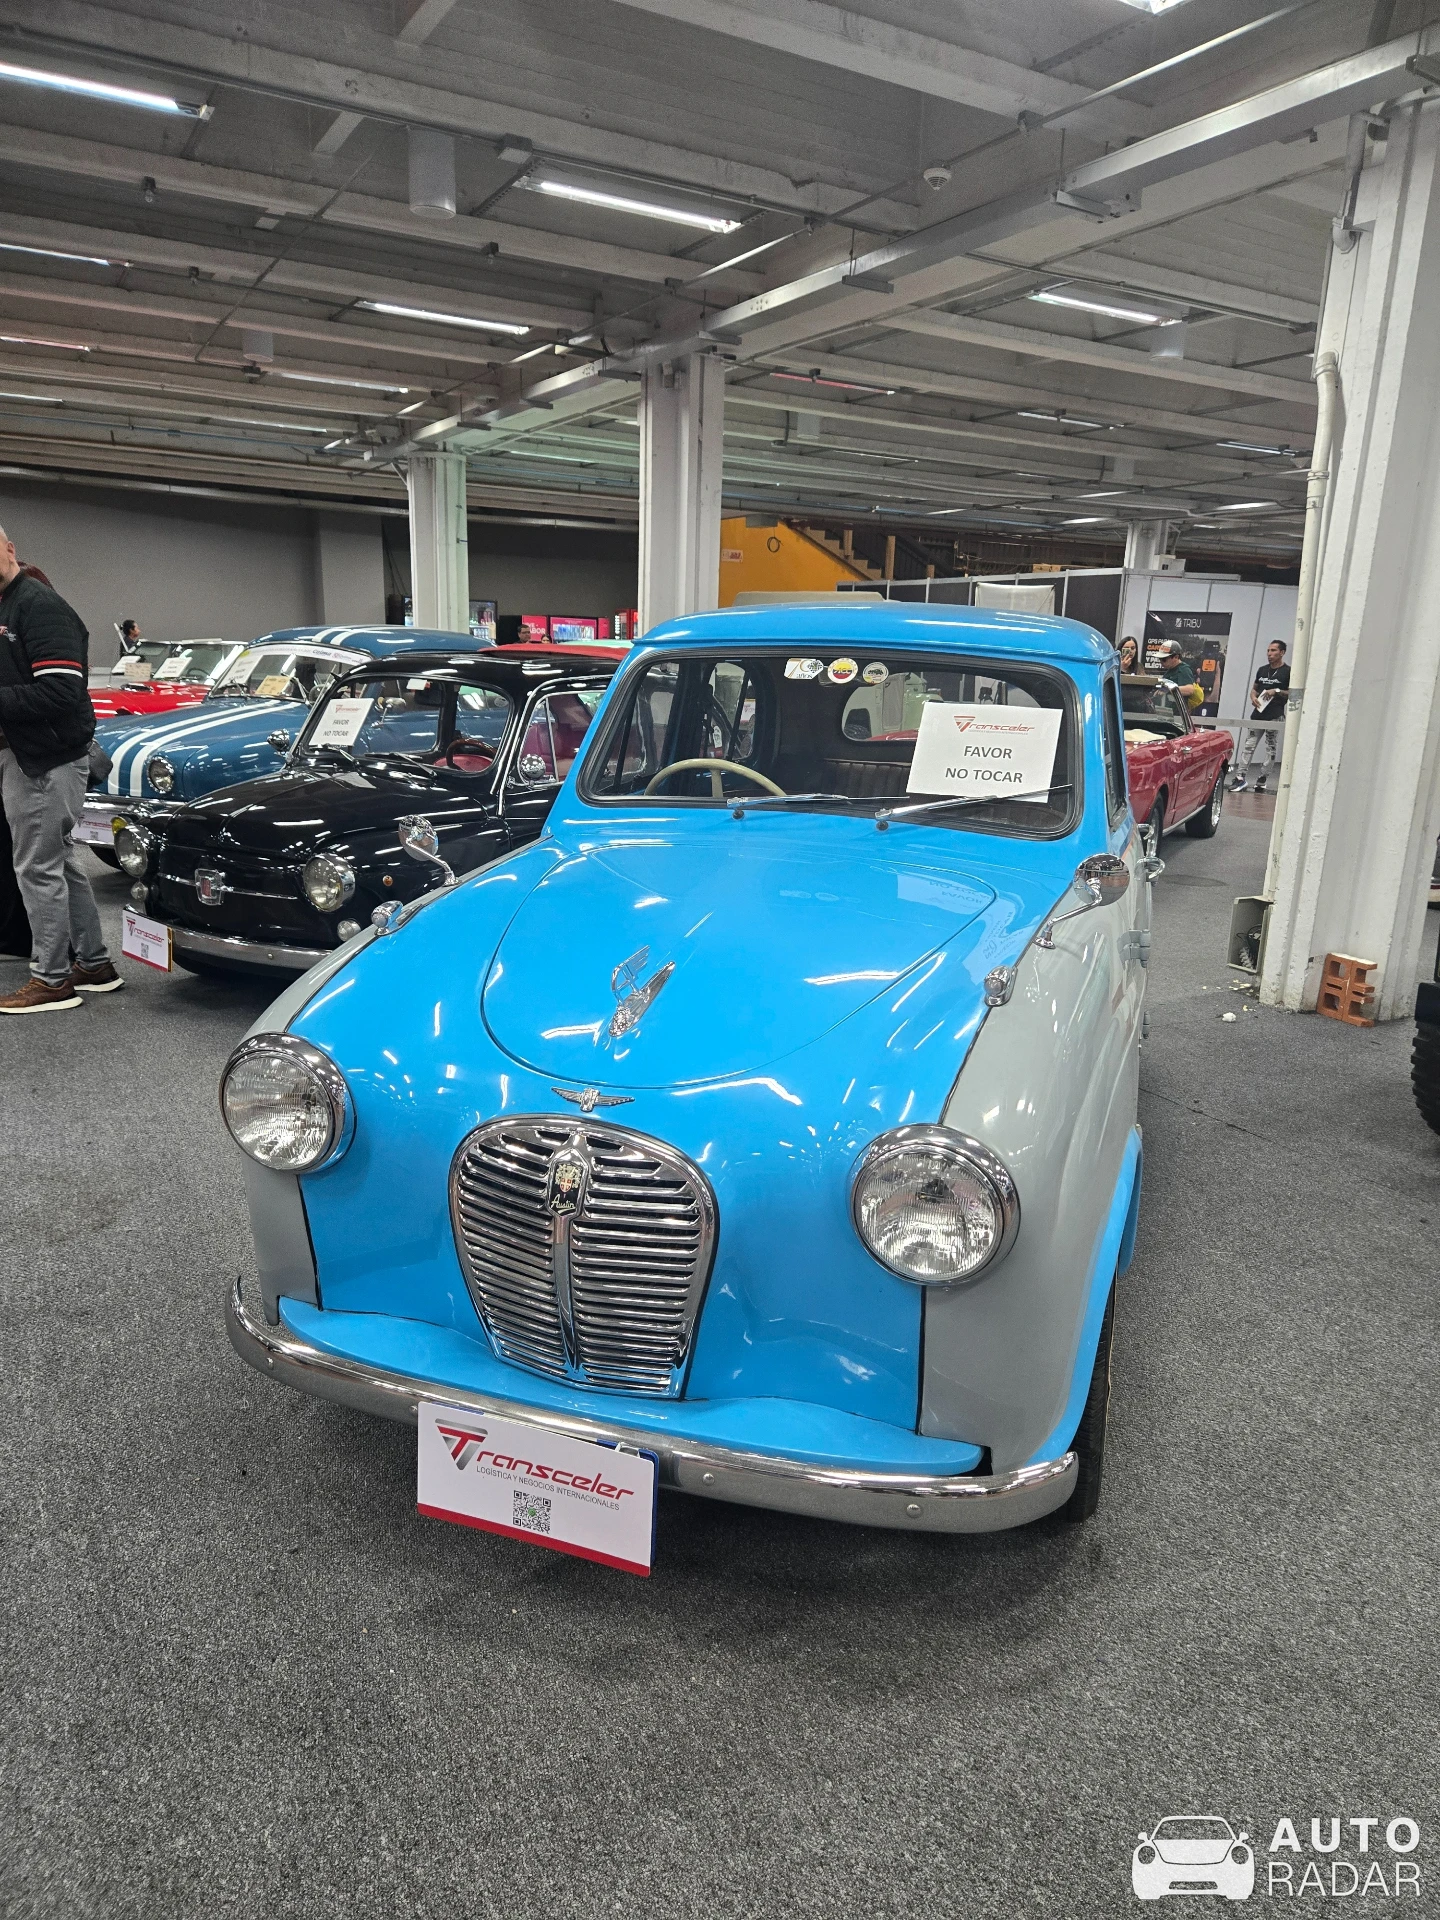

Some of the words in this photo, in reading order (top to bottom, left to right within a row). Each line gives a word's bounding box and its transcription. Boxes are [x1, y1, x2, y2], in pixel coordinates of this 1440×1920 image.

[953, 715, 1035, 733] Transceler
[963, 745, 1013, 759] FAVOR
[945, 767, 969, 779] NO
[973, 769, 1023, 783] TOCAR
[551, 1193, 575, 1209] Austin
[435, 1418, 634, 1500] Transceler
[476, 1465, 512, 1480] LOGÍSTICA
[518, 1477, 555, 1492] NEGOCIOS
[556, 1487, 620, 1511] INTERNACIONALES
